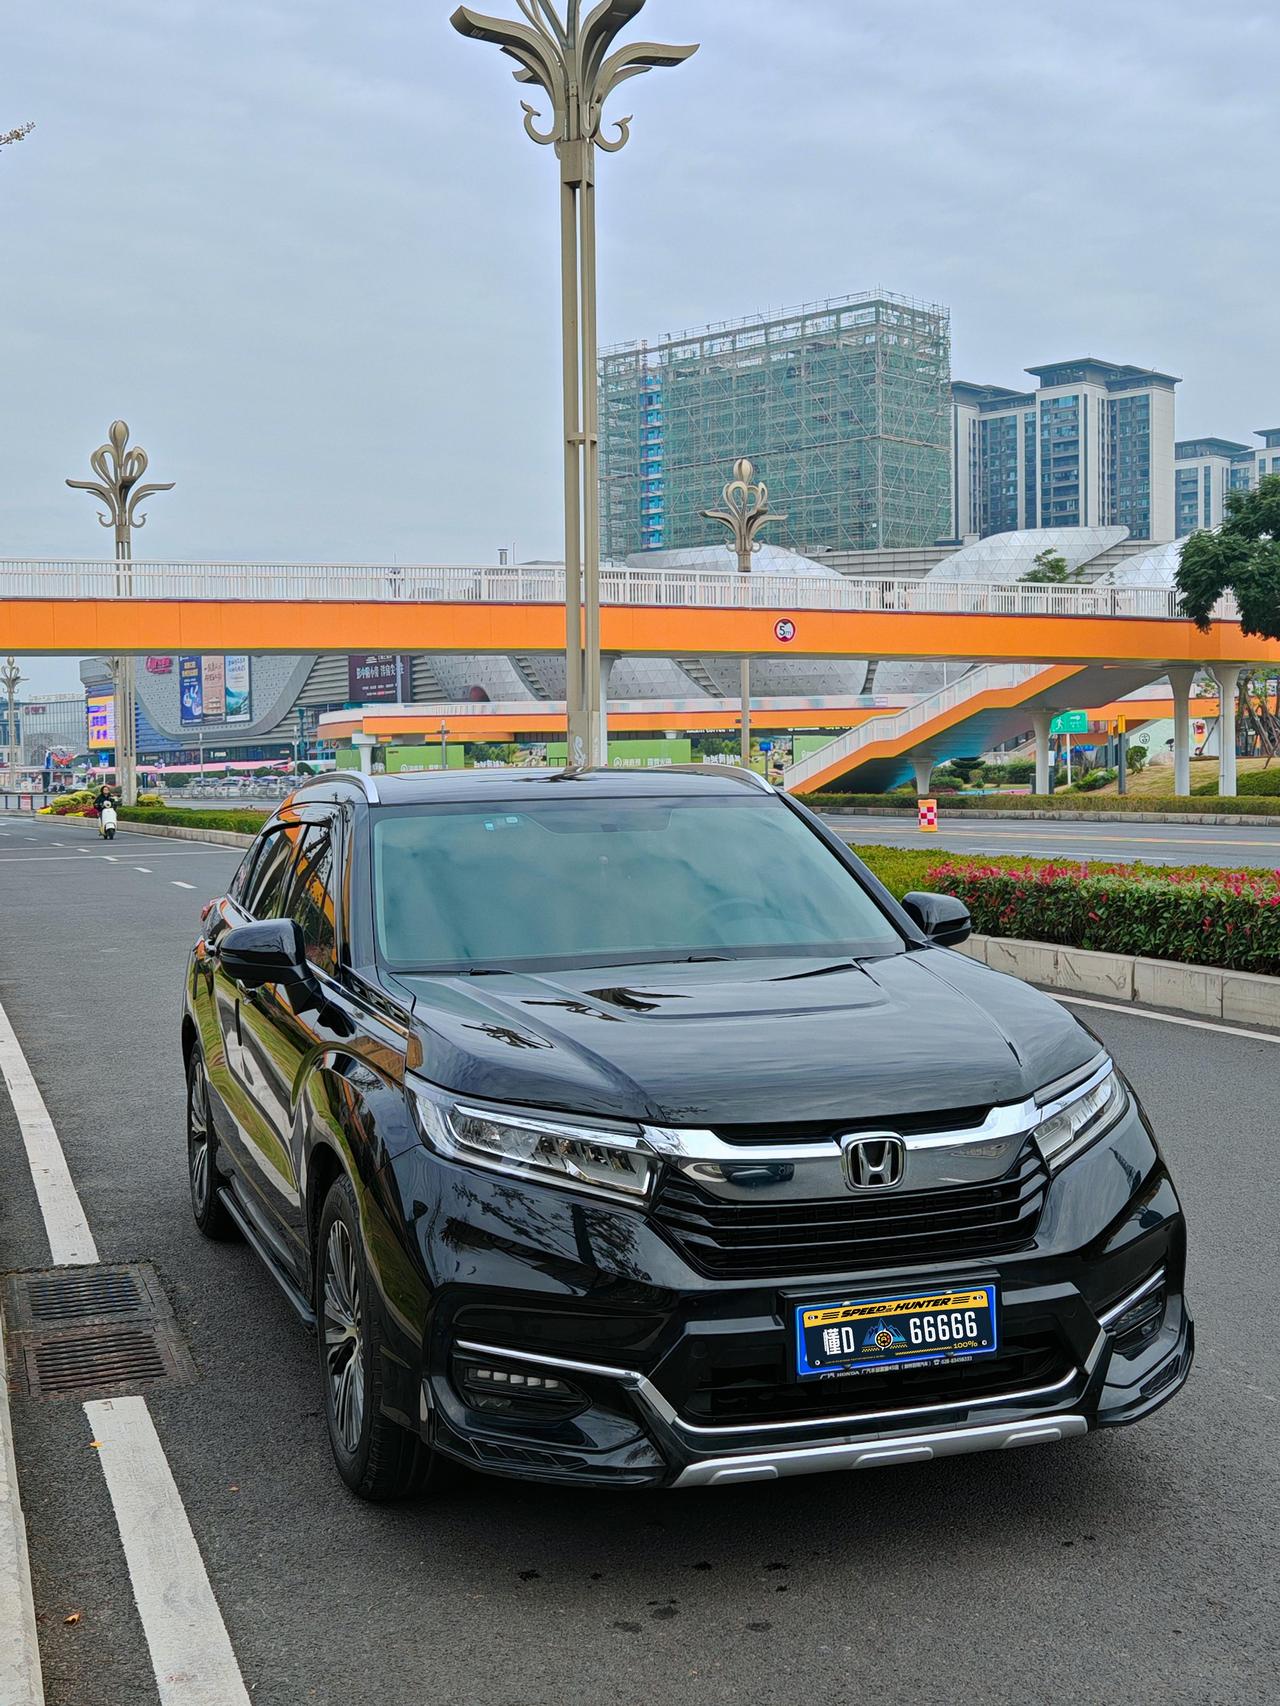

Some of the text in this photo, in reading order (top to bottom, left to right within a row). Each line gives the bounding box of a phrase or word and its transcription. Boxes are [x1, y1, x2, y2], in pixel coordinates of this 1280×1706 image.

[779, 625, 791, 636] 5m
[841, 1305, 887, 1318] SPEED
[893, 1297, 952, 1312] HUNTER
[909, 1311, 978, 1344] 66666
[953, 1340, 978, 1349] 100%
